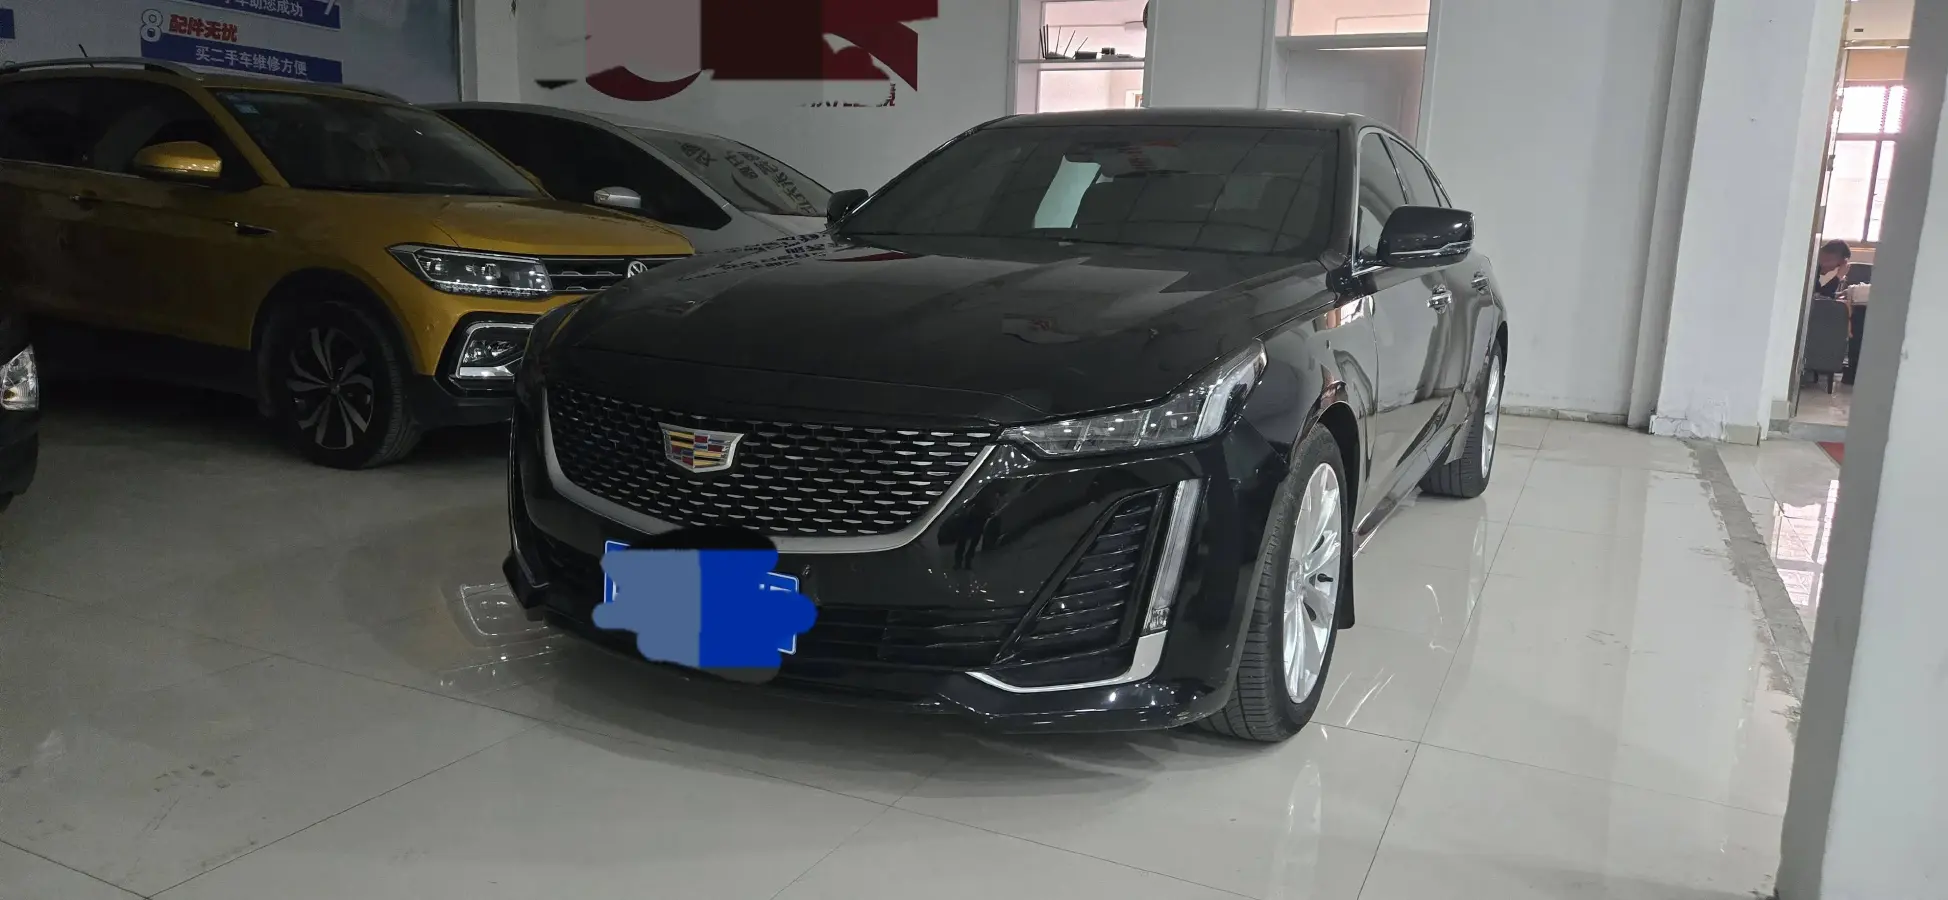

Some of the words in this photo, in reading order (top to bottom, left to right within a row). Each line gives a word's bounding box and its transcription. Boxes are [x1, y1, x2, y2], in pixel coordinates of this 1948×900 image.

[140, 8, 164, 43] 8
[195, 45, 307, 76] 买二手车维修方便
